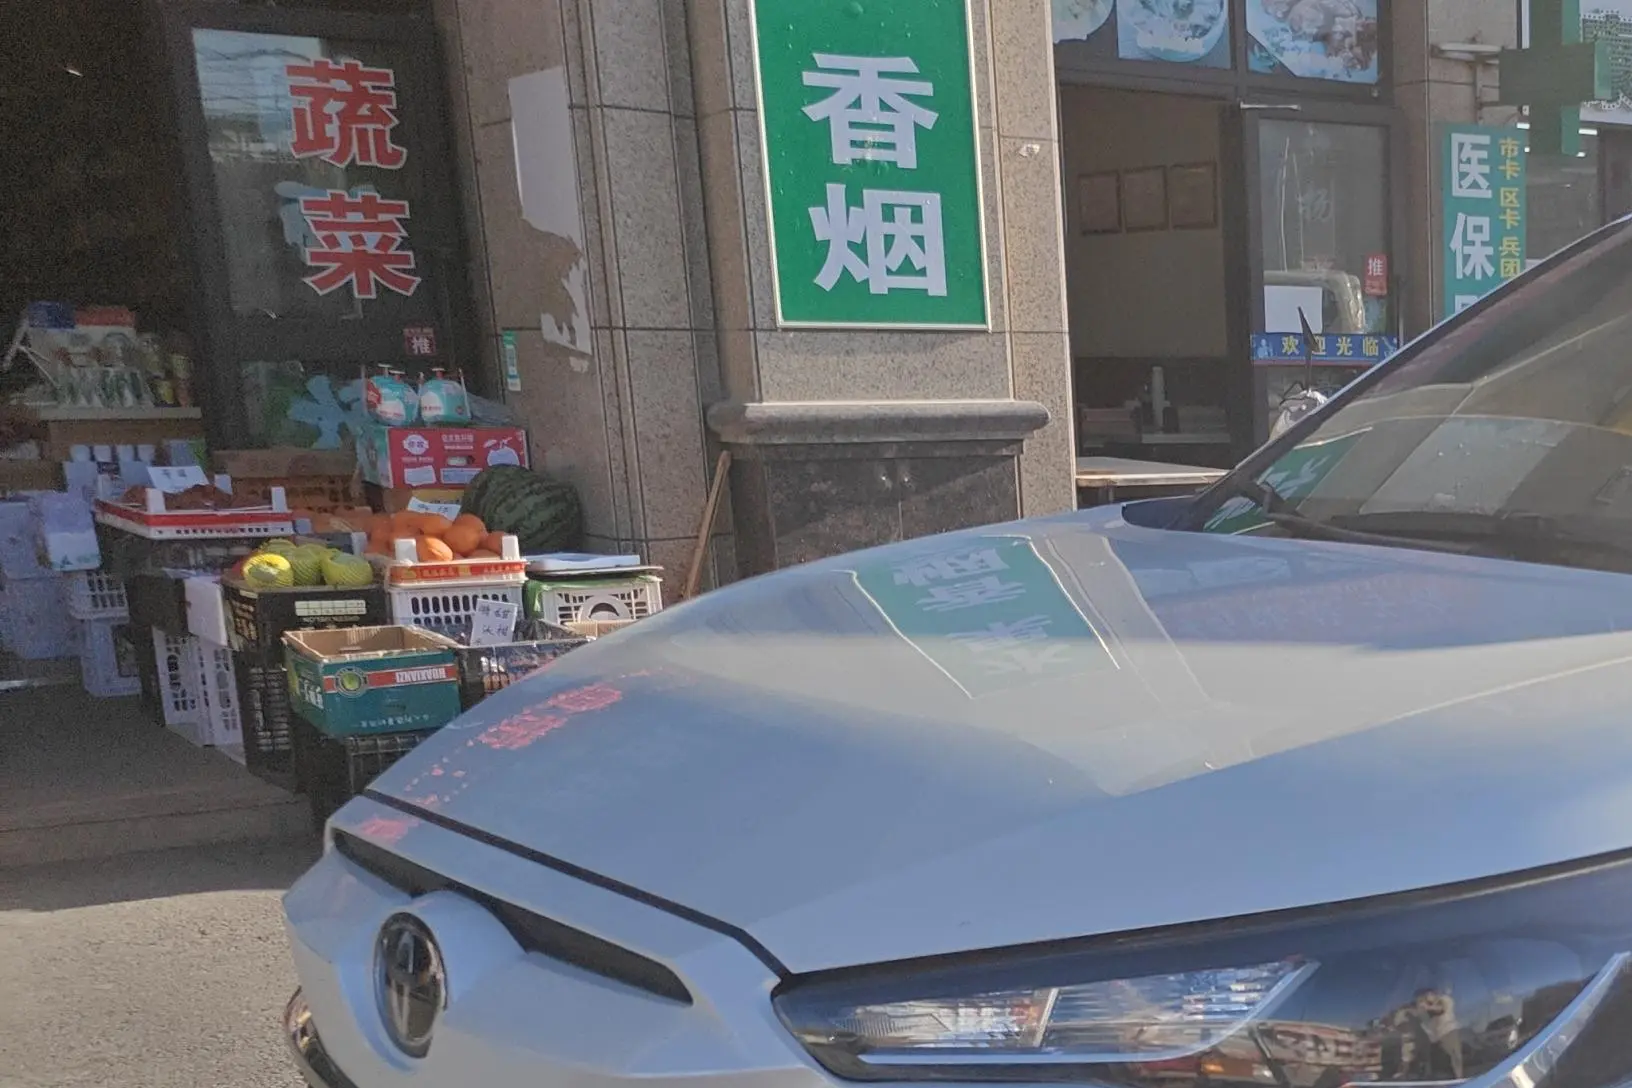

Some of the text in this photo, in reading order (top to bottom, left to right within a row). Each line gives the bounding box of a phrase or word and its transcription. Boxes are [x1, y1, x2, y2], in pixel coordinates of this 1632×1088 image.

[285, 57, 420, 299] 蔬菜
[801, 52, 948, 298] 香烟
[1498, 137, 1522, 279] 市卡 区卡 兵团
[1367, 257, 1384, 277] 推
[1281, 334, 1380, 357] 欢迎光临
